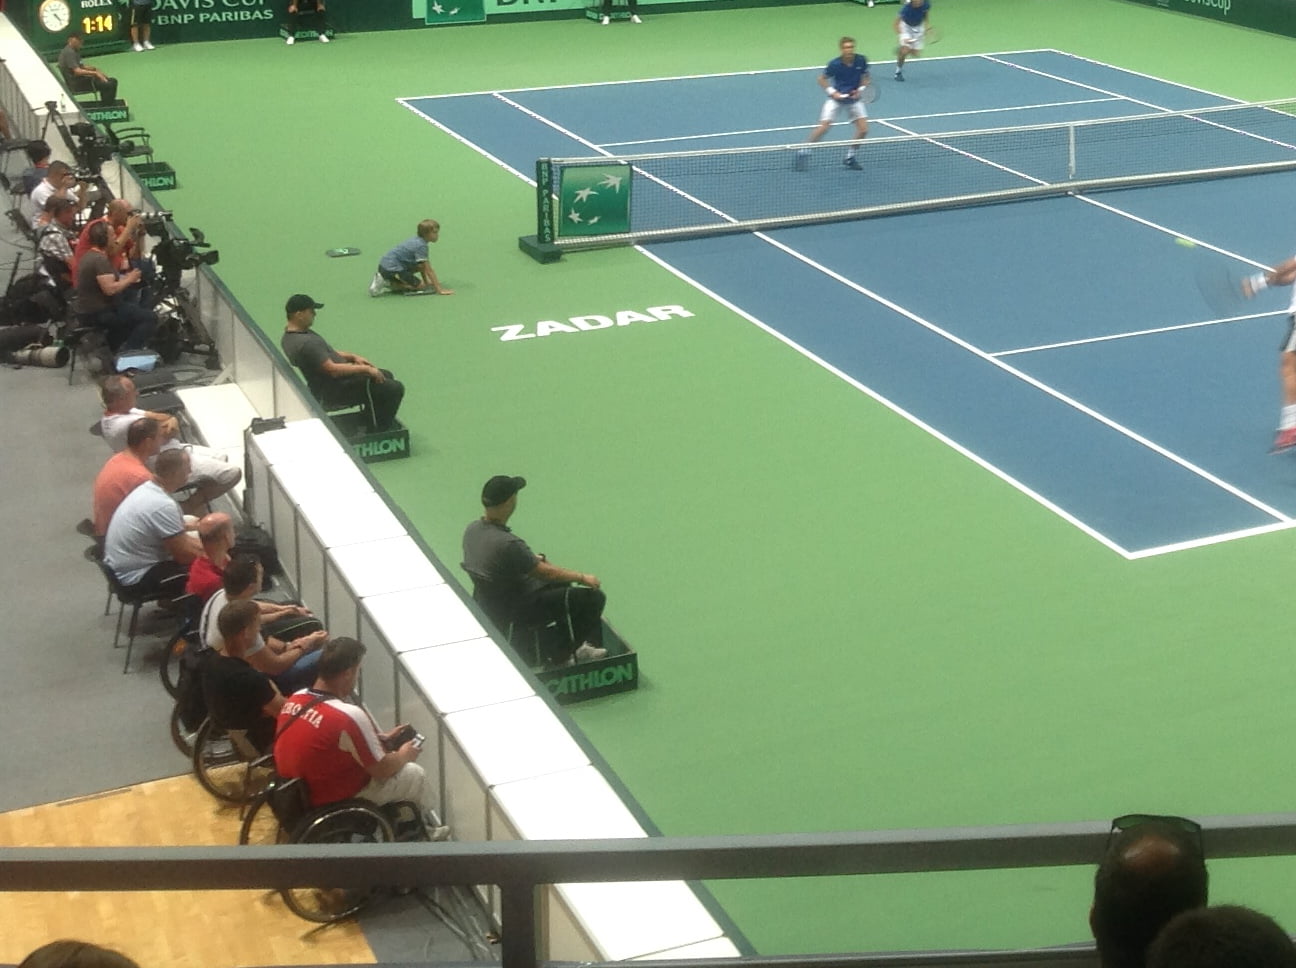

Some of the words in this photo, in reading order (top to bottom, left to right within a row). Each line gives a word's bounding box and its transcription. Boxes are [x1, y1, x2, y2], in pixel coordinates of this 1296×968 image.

[82, 14, 113, 34] 1:14
[157, 13, 194, 25] BNP
[199, 8, 275, 22] PARIBAS
[490, 304, 696, 341] ZADAR
[353, 438, 405, 458] THLON
[547, 663, 634, 696] CATHLON
